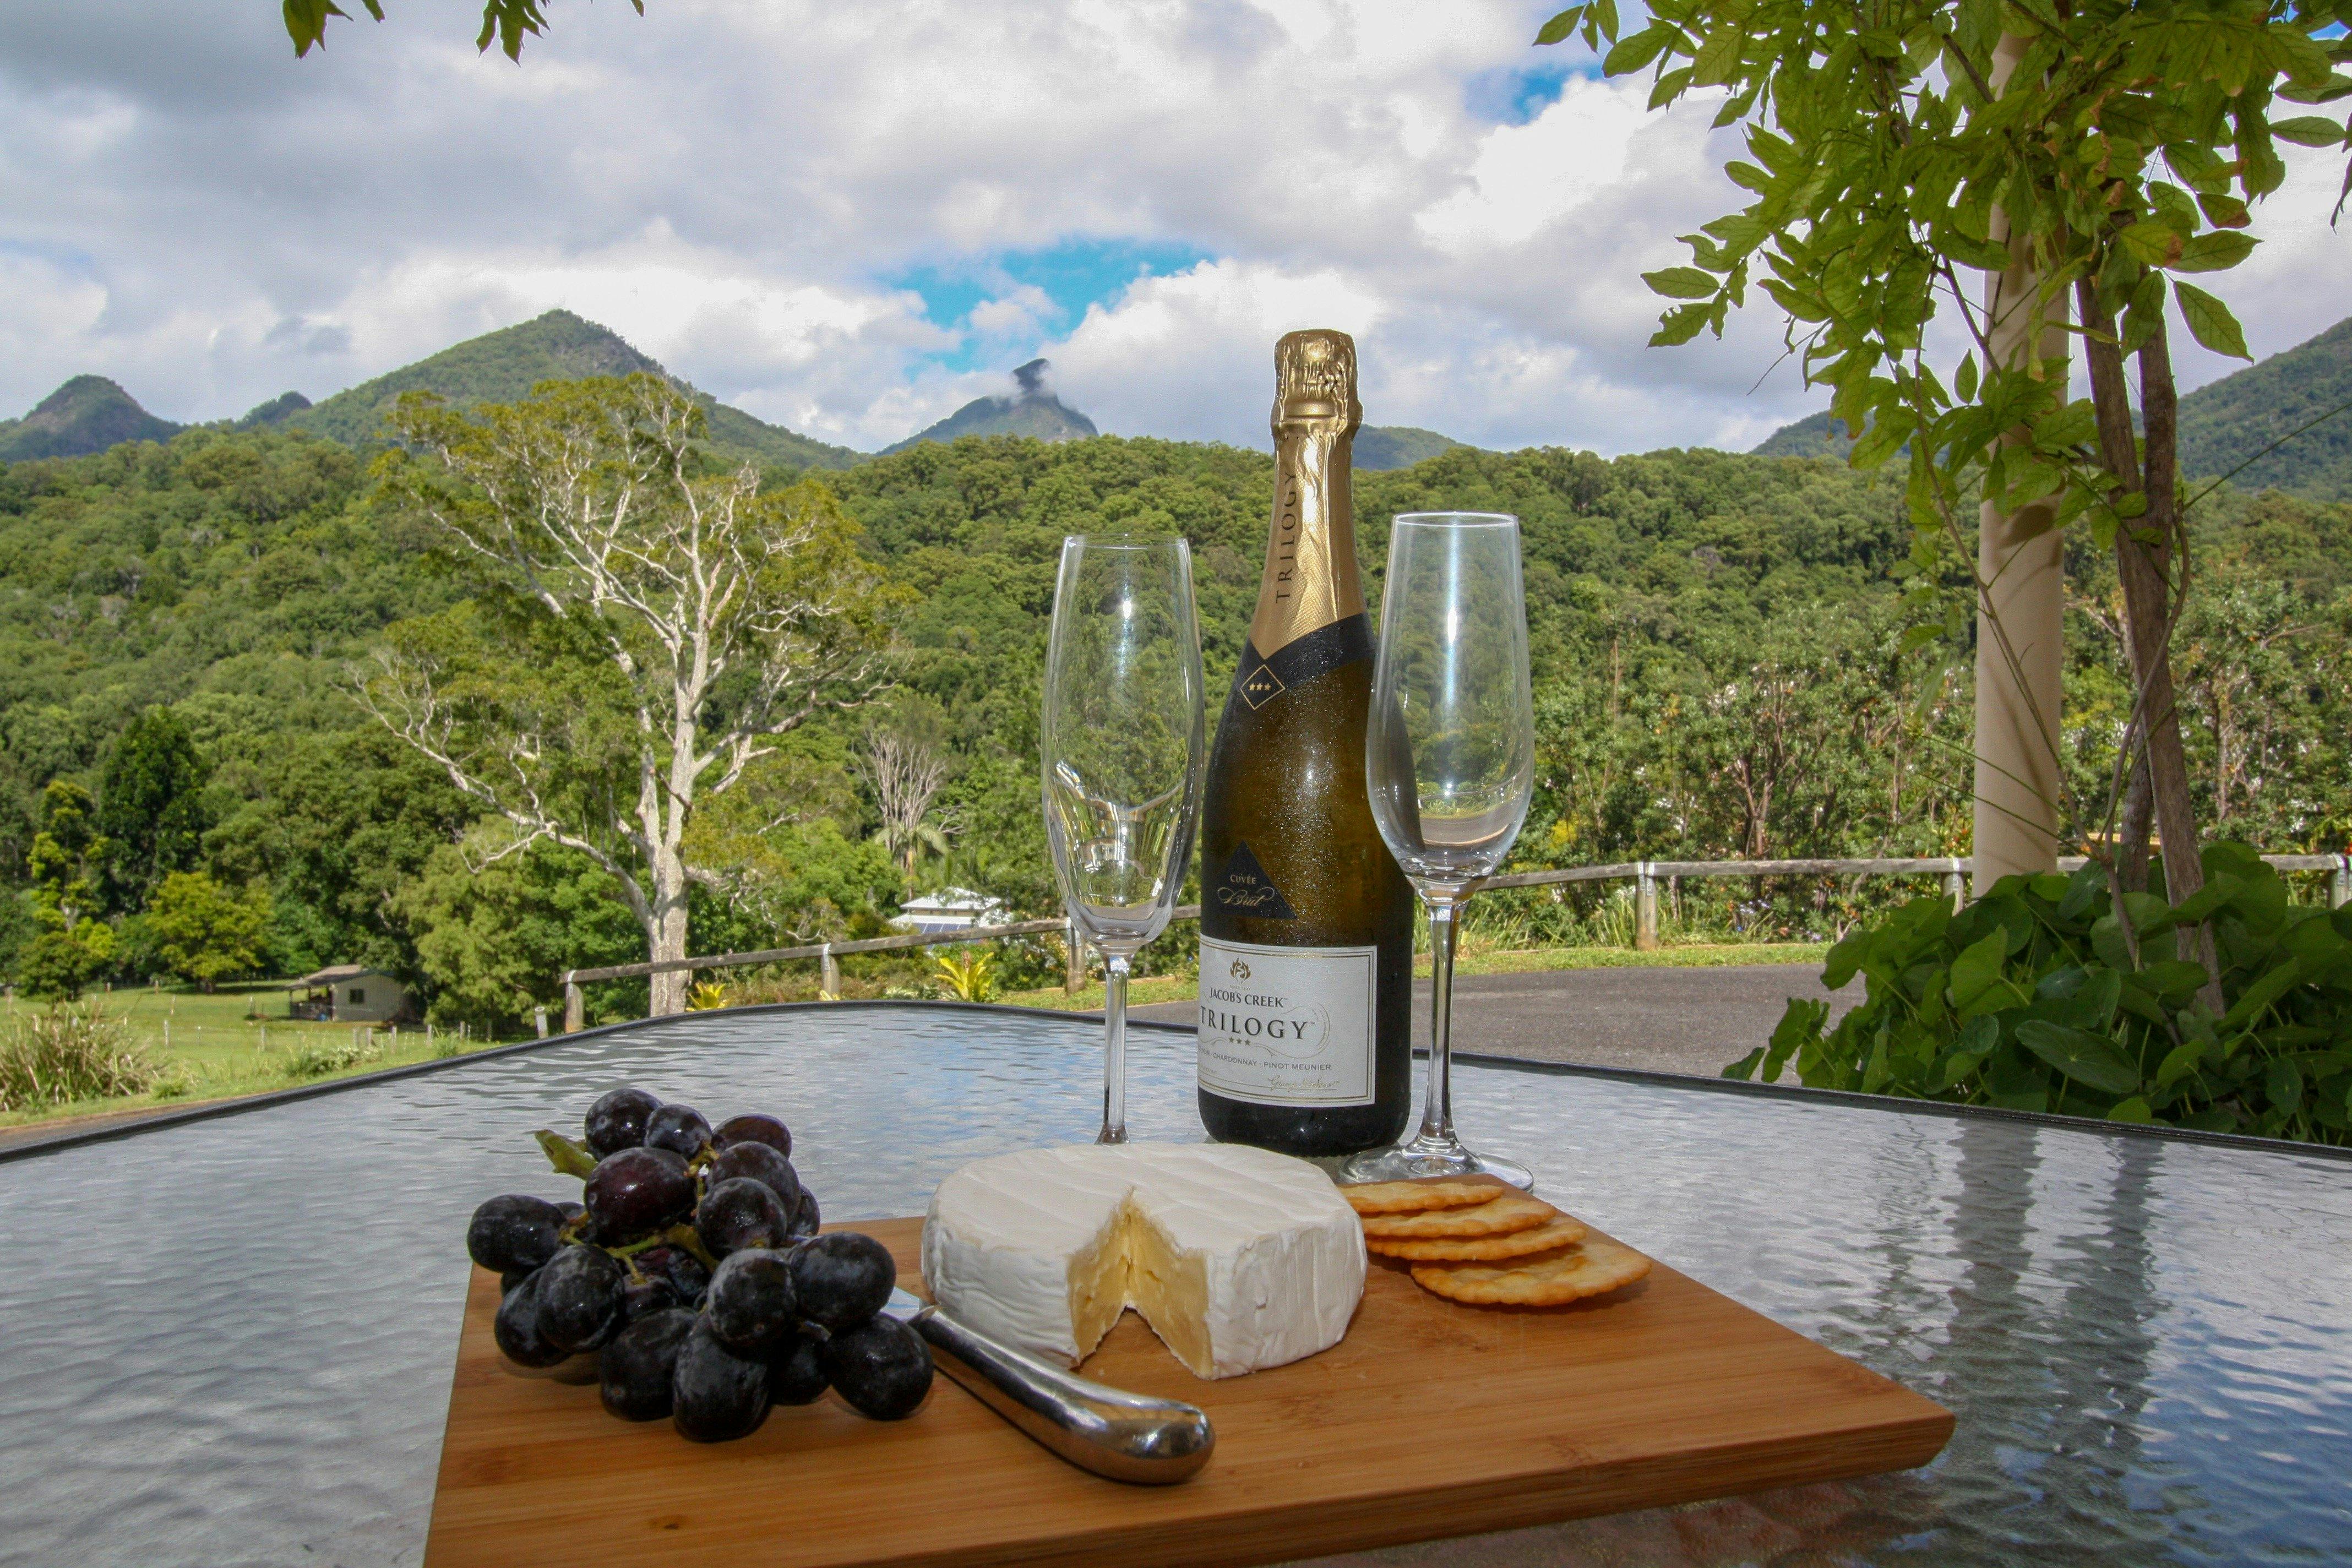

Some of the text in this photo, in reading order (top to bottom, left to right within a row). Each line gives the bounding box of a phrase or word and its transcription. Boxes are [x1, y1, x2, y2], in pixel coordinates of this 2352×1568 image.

[1275, 472, 1296, 603] TRILOGY
[1217, 886, 1275, 907] Brut
[1210, 987, 1242, 1004] JACOB'S
[1201, 1005, 1308, 1040] TRILOGY
[1212, 1052, 1257, 1067] CHARDONNAY
[1264, 1061, 1289, 1070] PINOT
